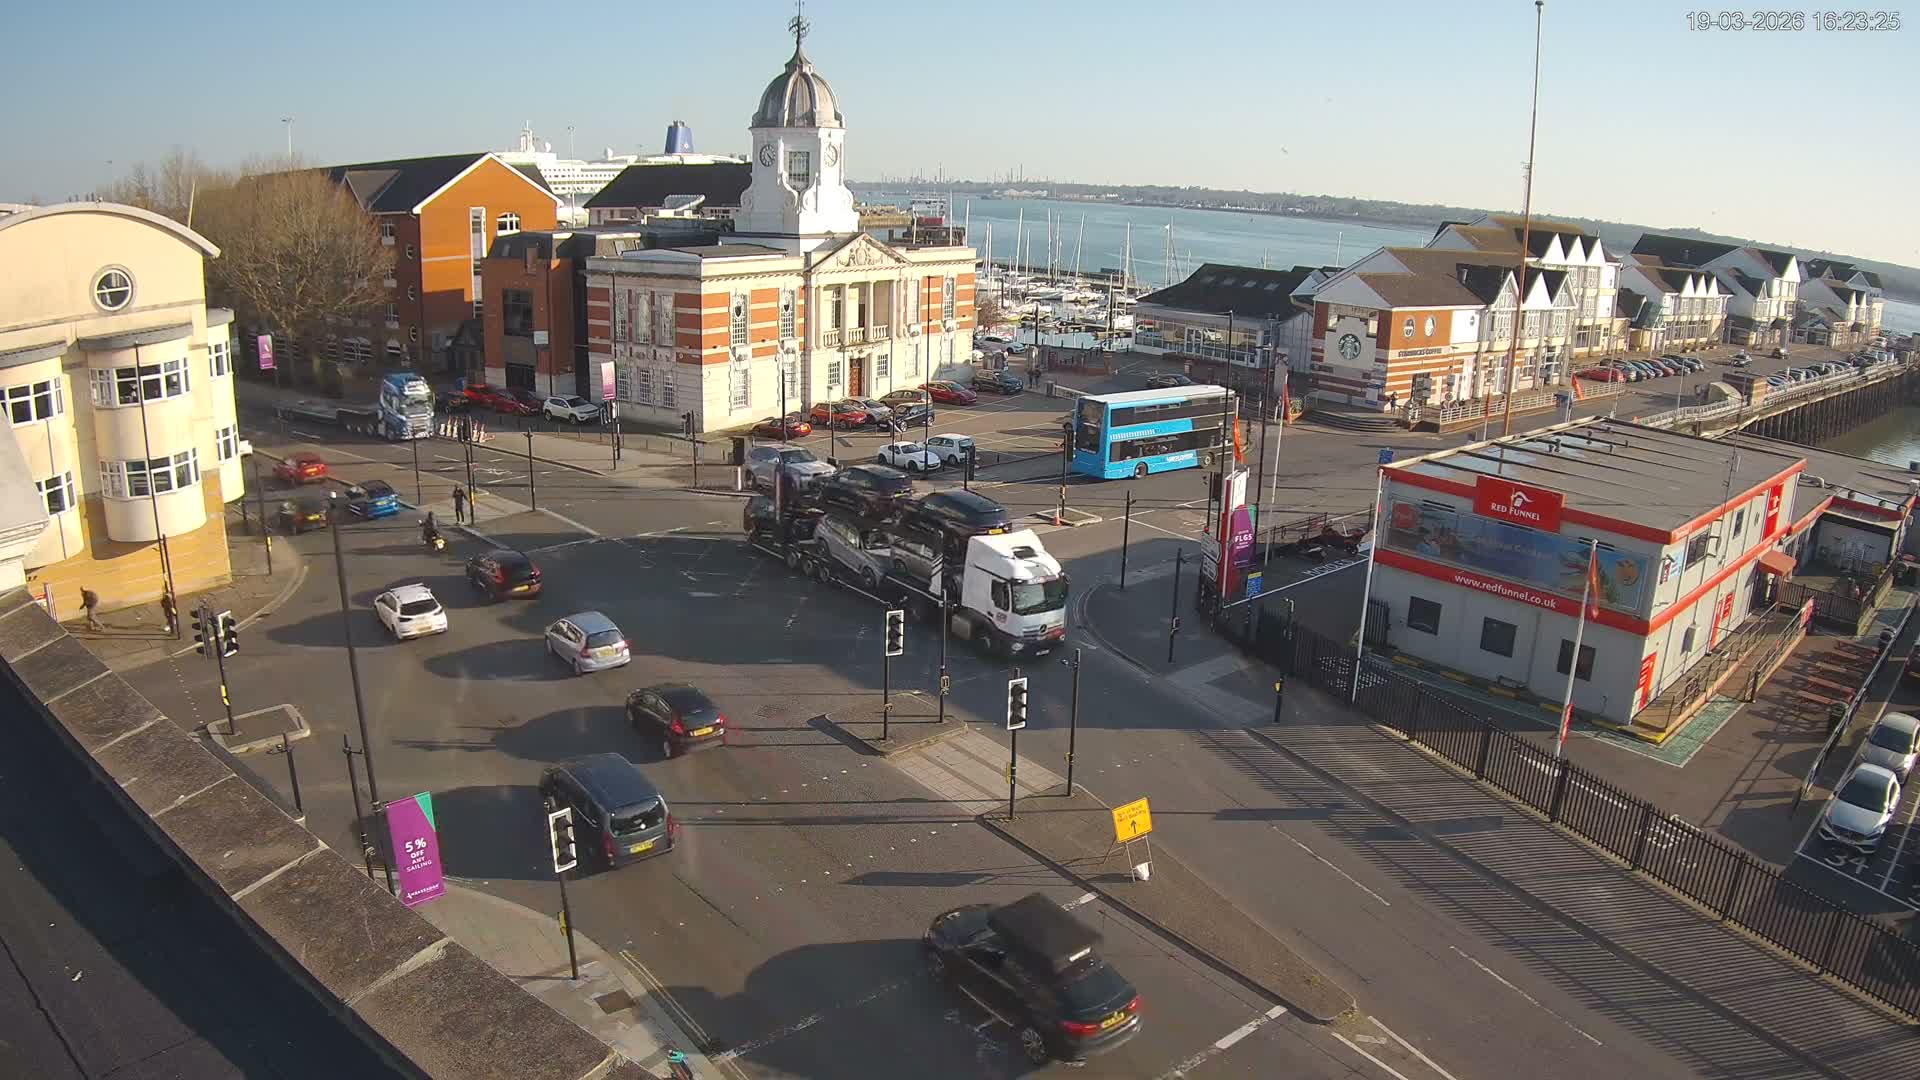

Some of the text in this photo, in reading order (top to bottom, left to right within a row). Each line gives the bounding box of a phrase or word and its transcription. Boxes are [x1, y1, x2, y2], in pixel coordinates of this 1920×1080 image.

[1491, 502, 1540, 521] RED FUNNEL
[1454, 574, 1557, 609] www.redfunnel.co.uk
[410, 849, 425, 859] OFF
[412, 856, 425, 865] ANY
[406, 859, 432, 873] SAILING
[1823, 852, 1870, 875] 34
